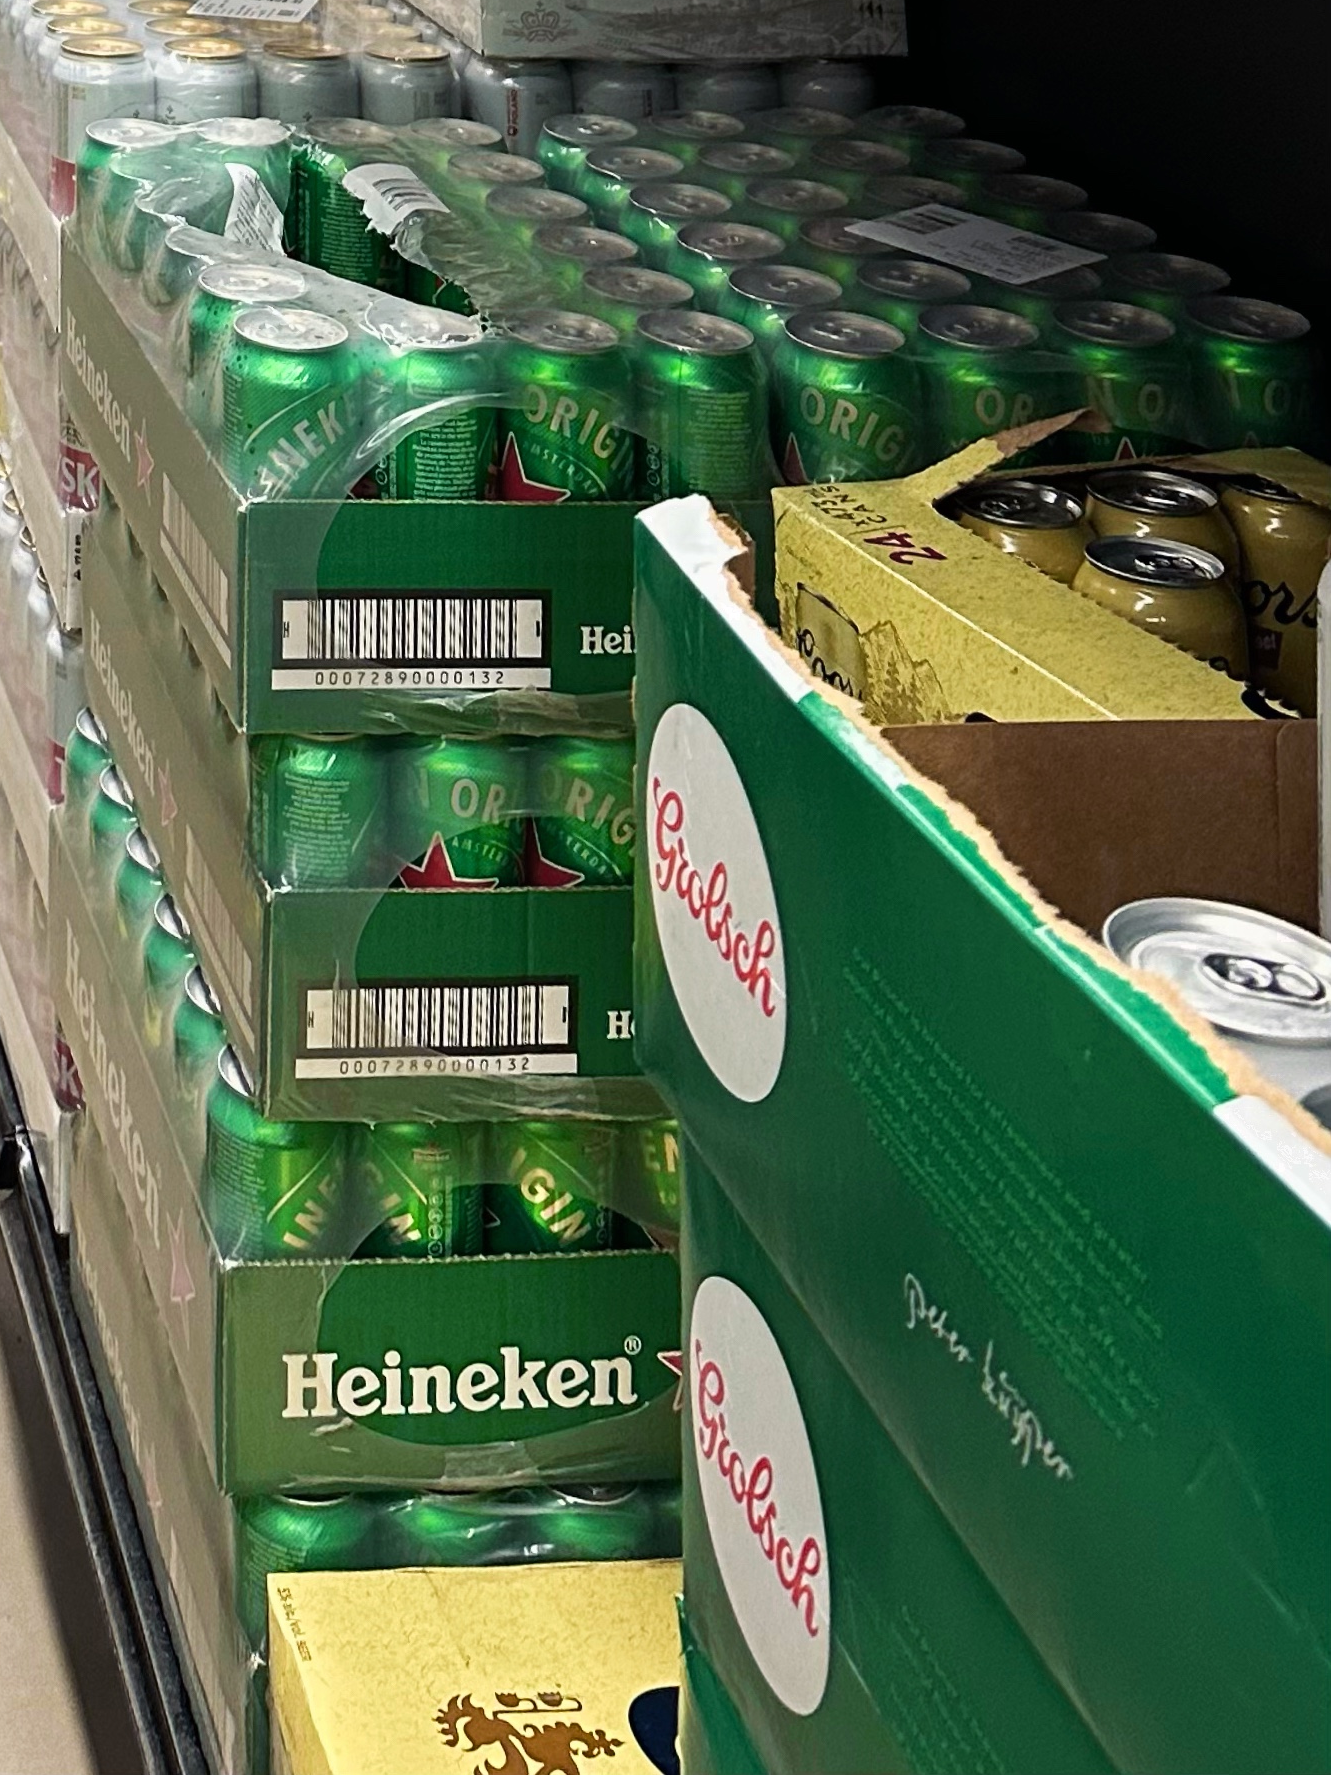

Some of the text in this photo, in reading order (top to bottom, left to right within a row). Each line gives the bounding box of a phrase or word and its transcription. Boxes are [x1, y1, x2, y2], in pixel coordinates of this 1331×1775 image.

[65, 307, 132, 464] Heineken
[522, 384, 622, 461] ORIG
[800, 385, 897, 462] ORIG
[820, 485, 887, 524] CANS
[864, 532, 948, 565] 24
[90, 621, 155, 796] Heineken
[315, 670, 505, 686] 00072890000132
[652, 776, 777, 1019] Grolsch
[340, 1057, 531, 1074] 00072890000132
[281, 1347, 638, 1419] Heineken
[693, 1339, 819, 1639] Grolsch
